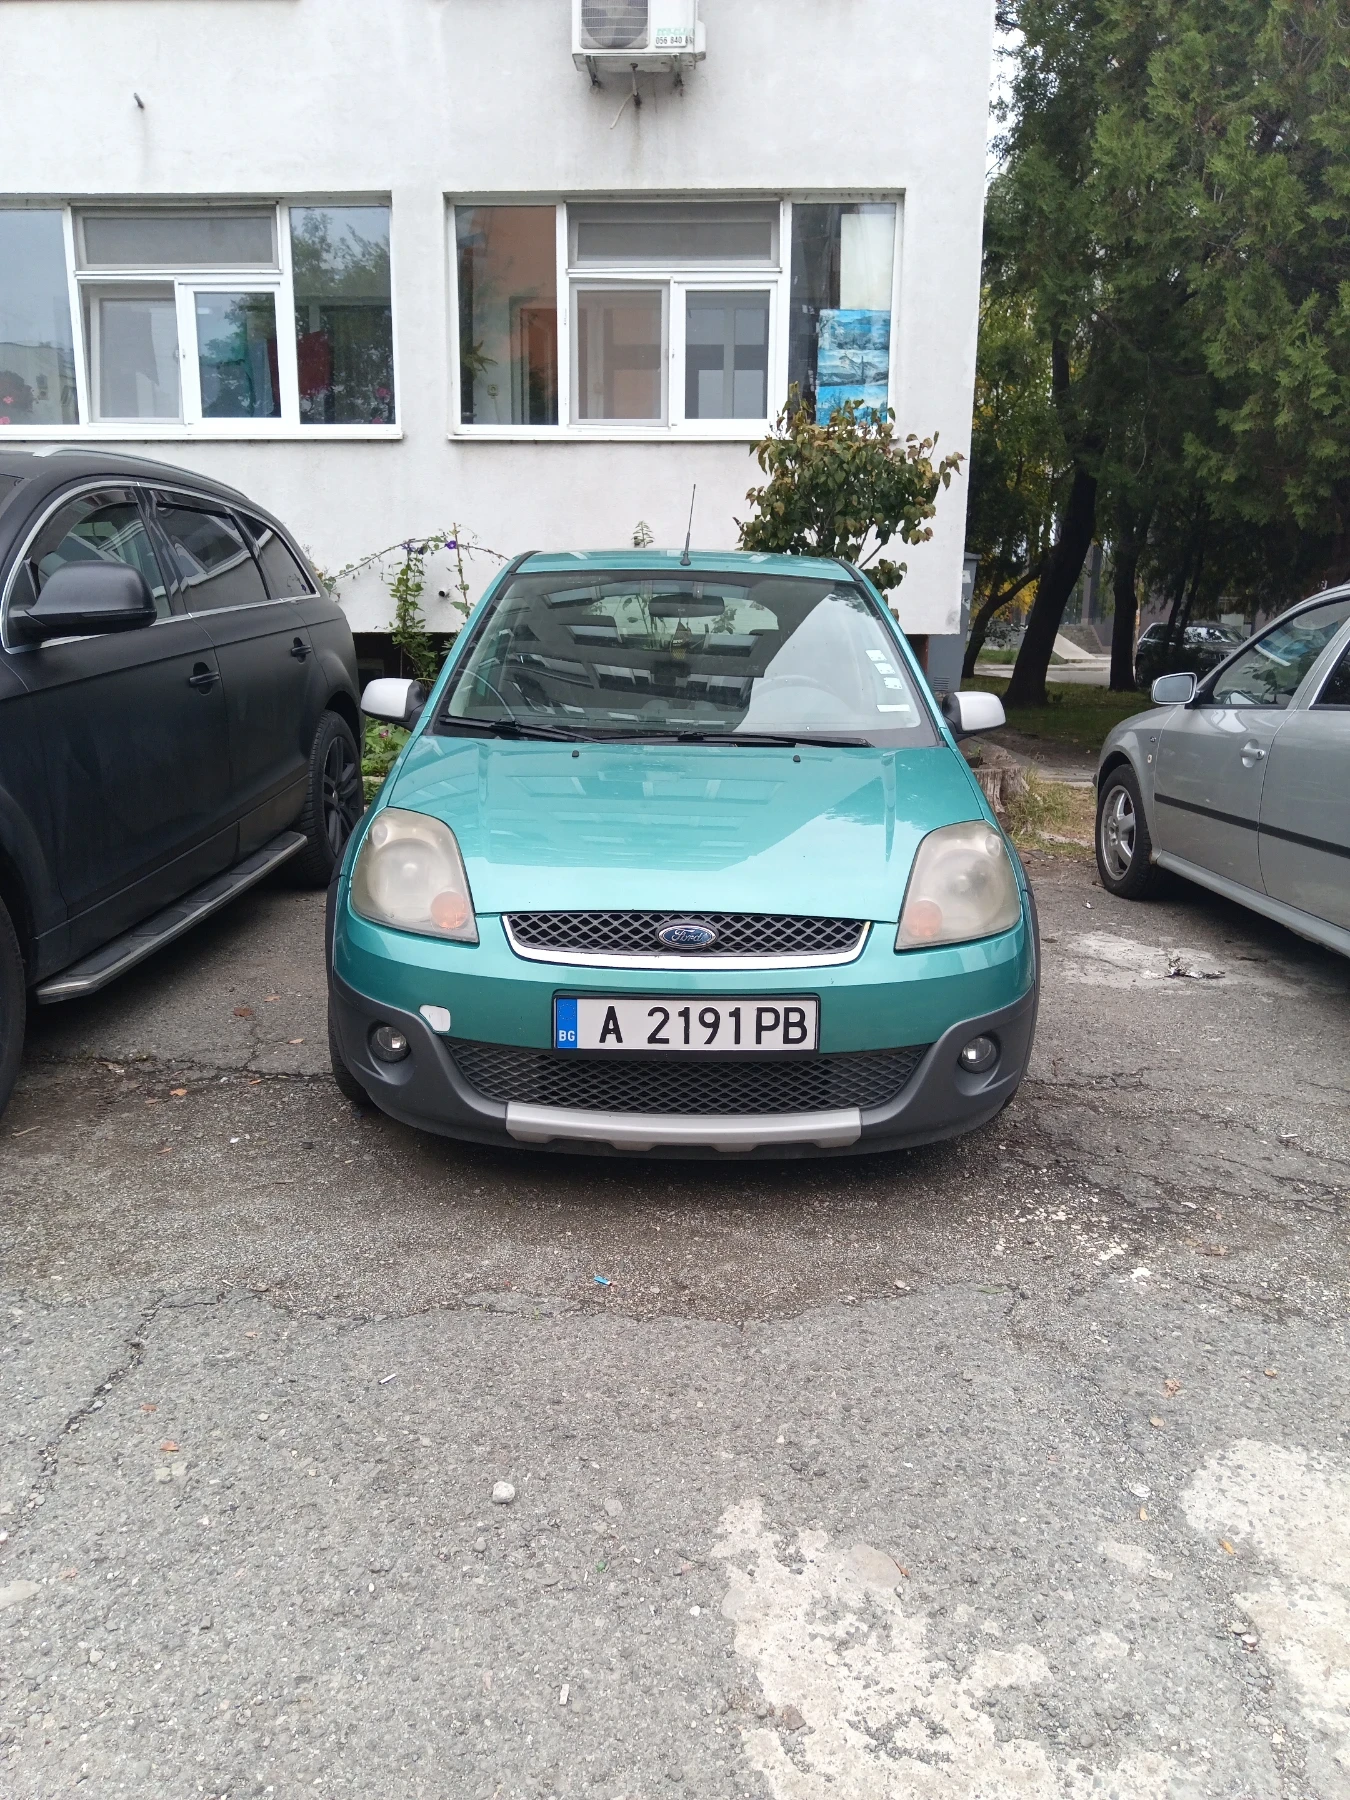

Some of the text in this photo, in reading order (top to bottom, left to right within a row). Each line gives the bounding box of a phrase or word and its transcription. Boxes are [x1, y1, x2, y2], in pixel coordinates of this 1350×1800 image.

[671, 927, 704, 942] Ford
[598, 1005, 624, 1044] A
[558, 1030, 576, 1042] BG
